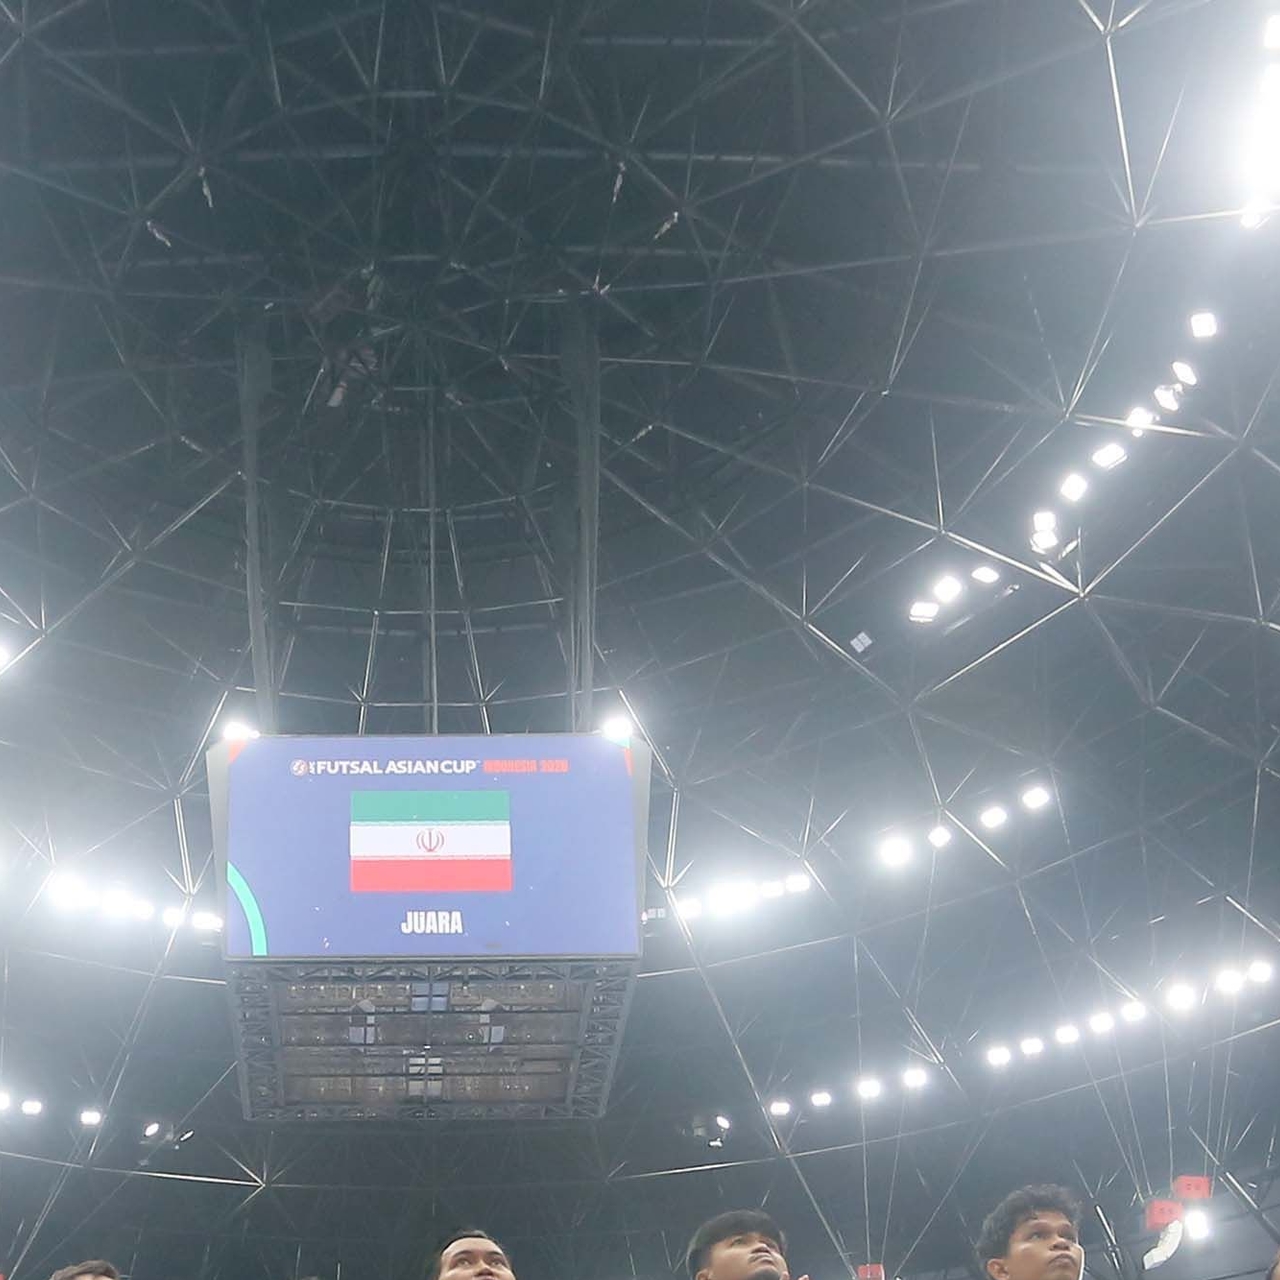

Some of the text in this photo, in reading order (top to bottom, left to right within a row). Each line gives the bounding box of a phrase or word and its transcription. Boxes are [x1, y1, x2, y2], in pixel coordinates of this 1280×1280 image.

[317, 760, 381, 775] FUTSAL
[385, 760, 440, 775] ASIAN
[441, 760, 477, 775] CUP
[401, 910, 463, 934] JUARA
